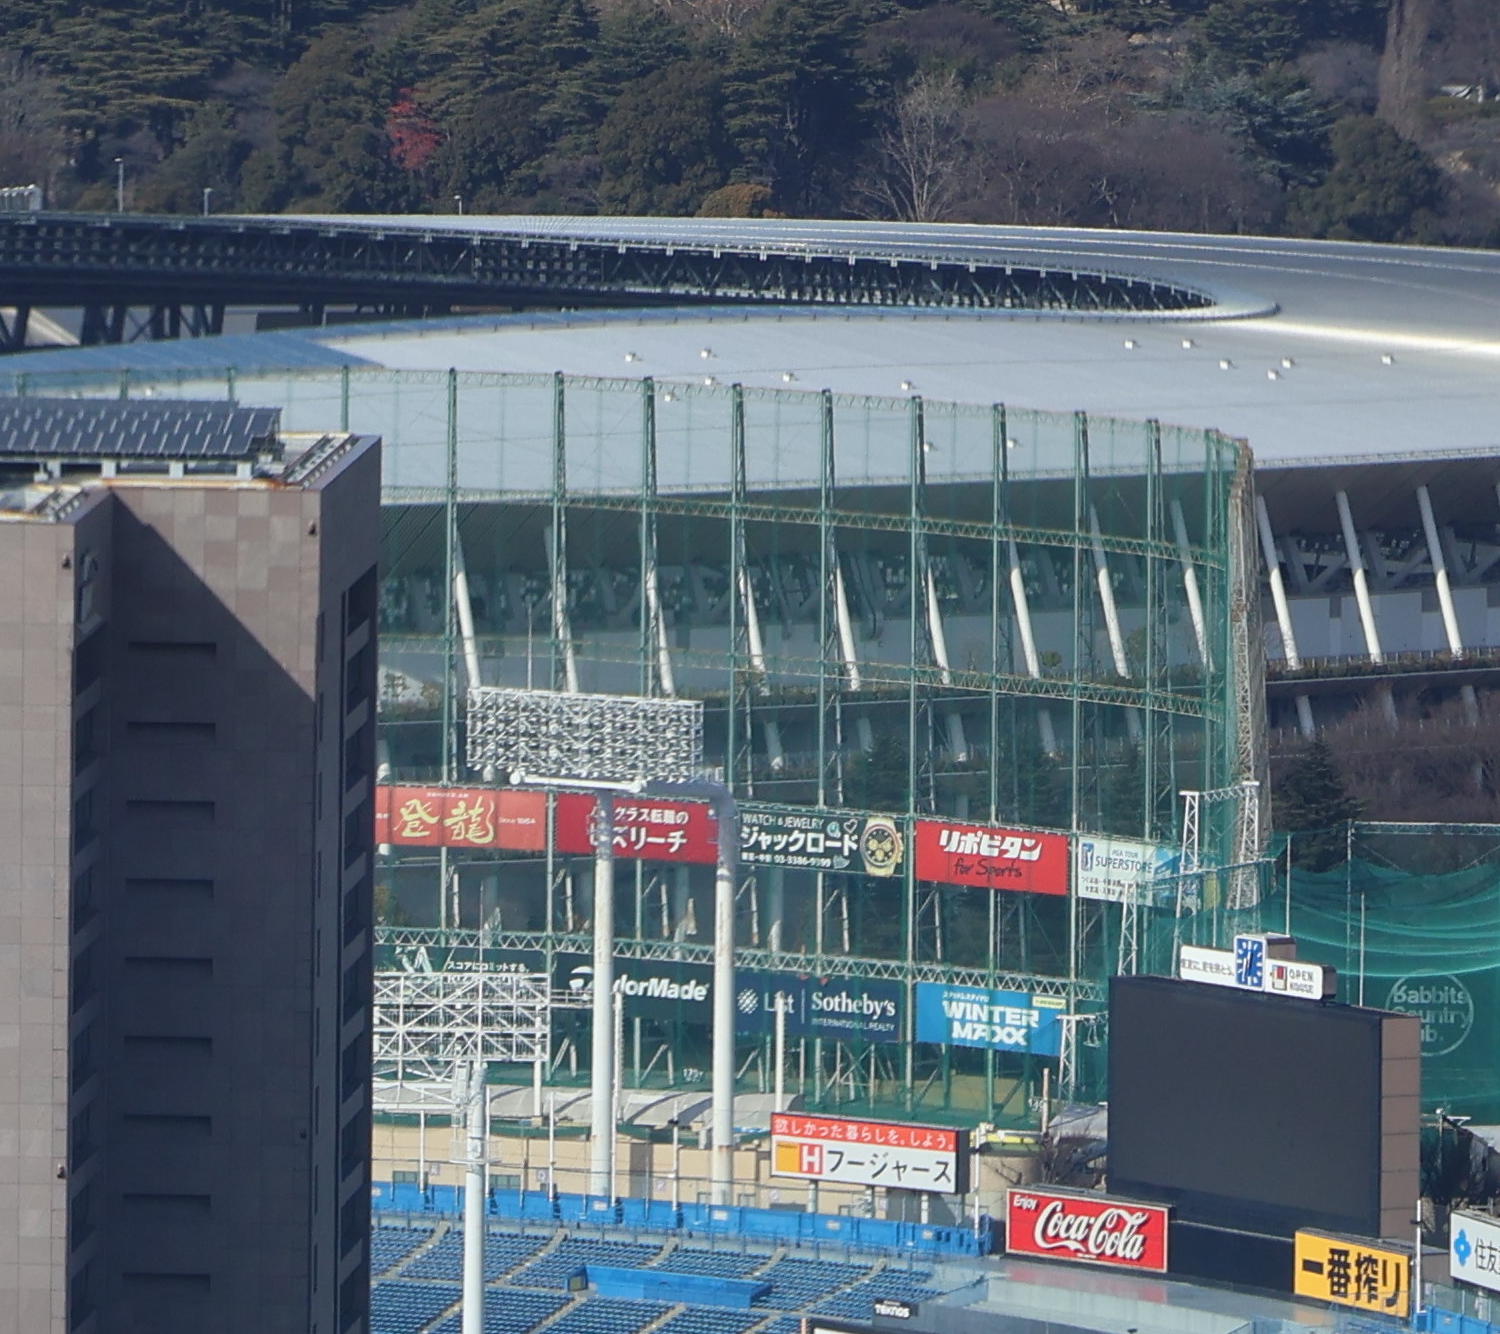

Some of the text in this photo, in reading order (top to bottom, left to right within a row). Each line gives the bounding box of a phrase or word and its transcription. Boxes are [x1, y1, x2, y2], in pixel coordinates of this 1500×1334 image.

[393, 796, 495, 845] 登龍
[742, 814, 776, 826] WATCH
[784, 816, 825, 830] JEWELRY
[741, 826, 858, 857] ジャックロード
[939, 829, 1043, 861] リポビタン
[953, 857, 1022, 880] for Sports
[1095, 856, 1153, 874] SUPERSTORE
[1288, 968, 1314, 982] OPEN
[811, 990, 896, 1019] Sotheby's
[942, 1000, 1039, 1028] WINTER
[867, 1021, 895, 1032] REALTY
[951, 1021, 1028, 1046] MAXX
[827, 1150, 951, 1184] フージャース
[1013, 1194, 1038, 1212] Enjoy
[1301, 1247, 1402, 1307] 一番搾り
